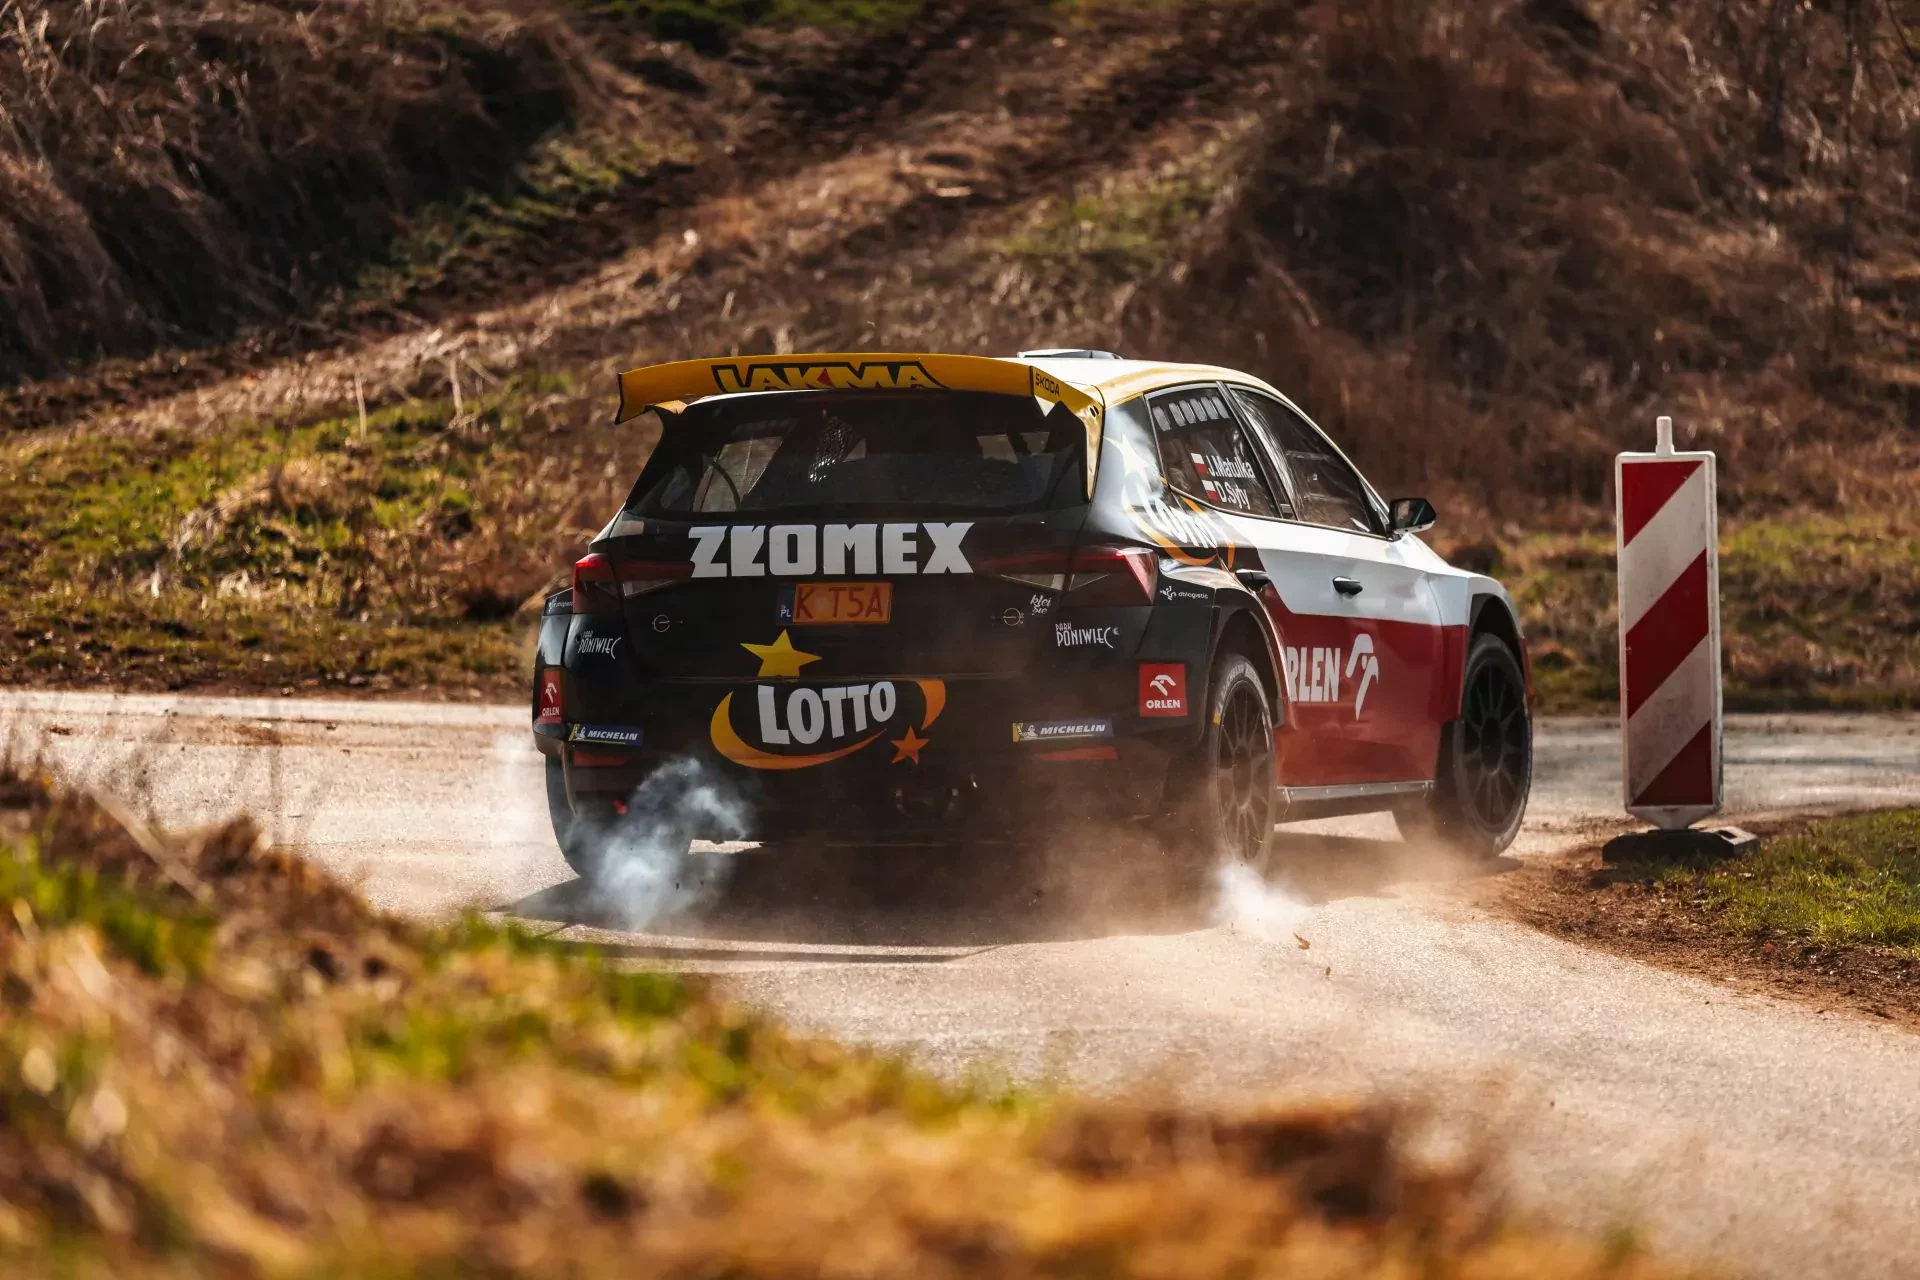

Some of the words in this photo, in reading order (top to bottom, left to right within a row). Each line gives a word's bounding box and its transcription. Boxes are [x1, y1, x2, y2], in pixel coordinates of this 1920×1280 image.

[1205, 454, 1256, 479] J.Matulka
[1213, 480, 1250, 510] D.Syty
[780, 608, 792, 618] PL
[795, 587, 815, 619] K
[828, 586, 884, 619] T5A
[578, 636, 622, 660] PONIWIEC
[1056, 627, 1114, 649] PONIWIEC
[1285, 646, 1341, 703] RLEN
[542, 706, 560, 717] ORLEN
[757, 681, 897, 745] LOTTO
[1146, 699, 1181, 710] ORLEN
[587, 729, 638, 741] MICHELIN
[1040, 724, 1106, 735] MICHELIN
